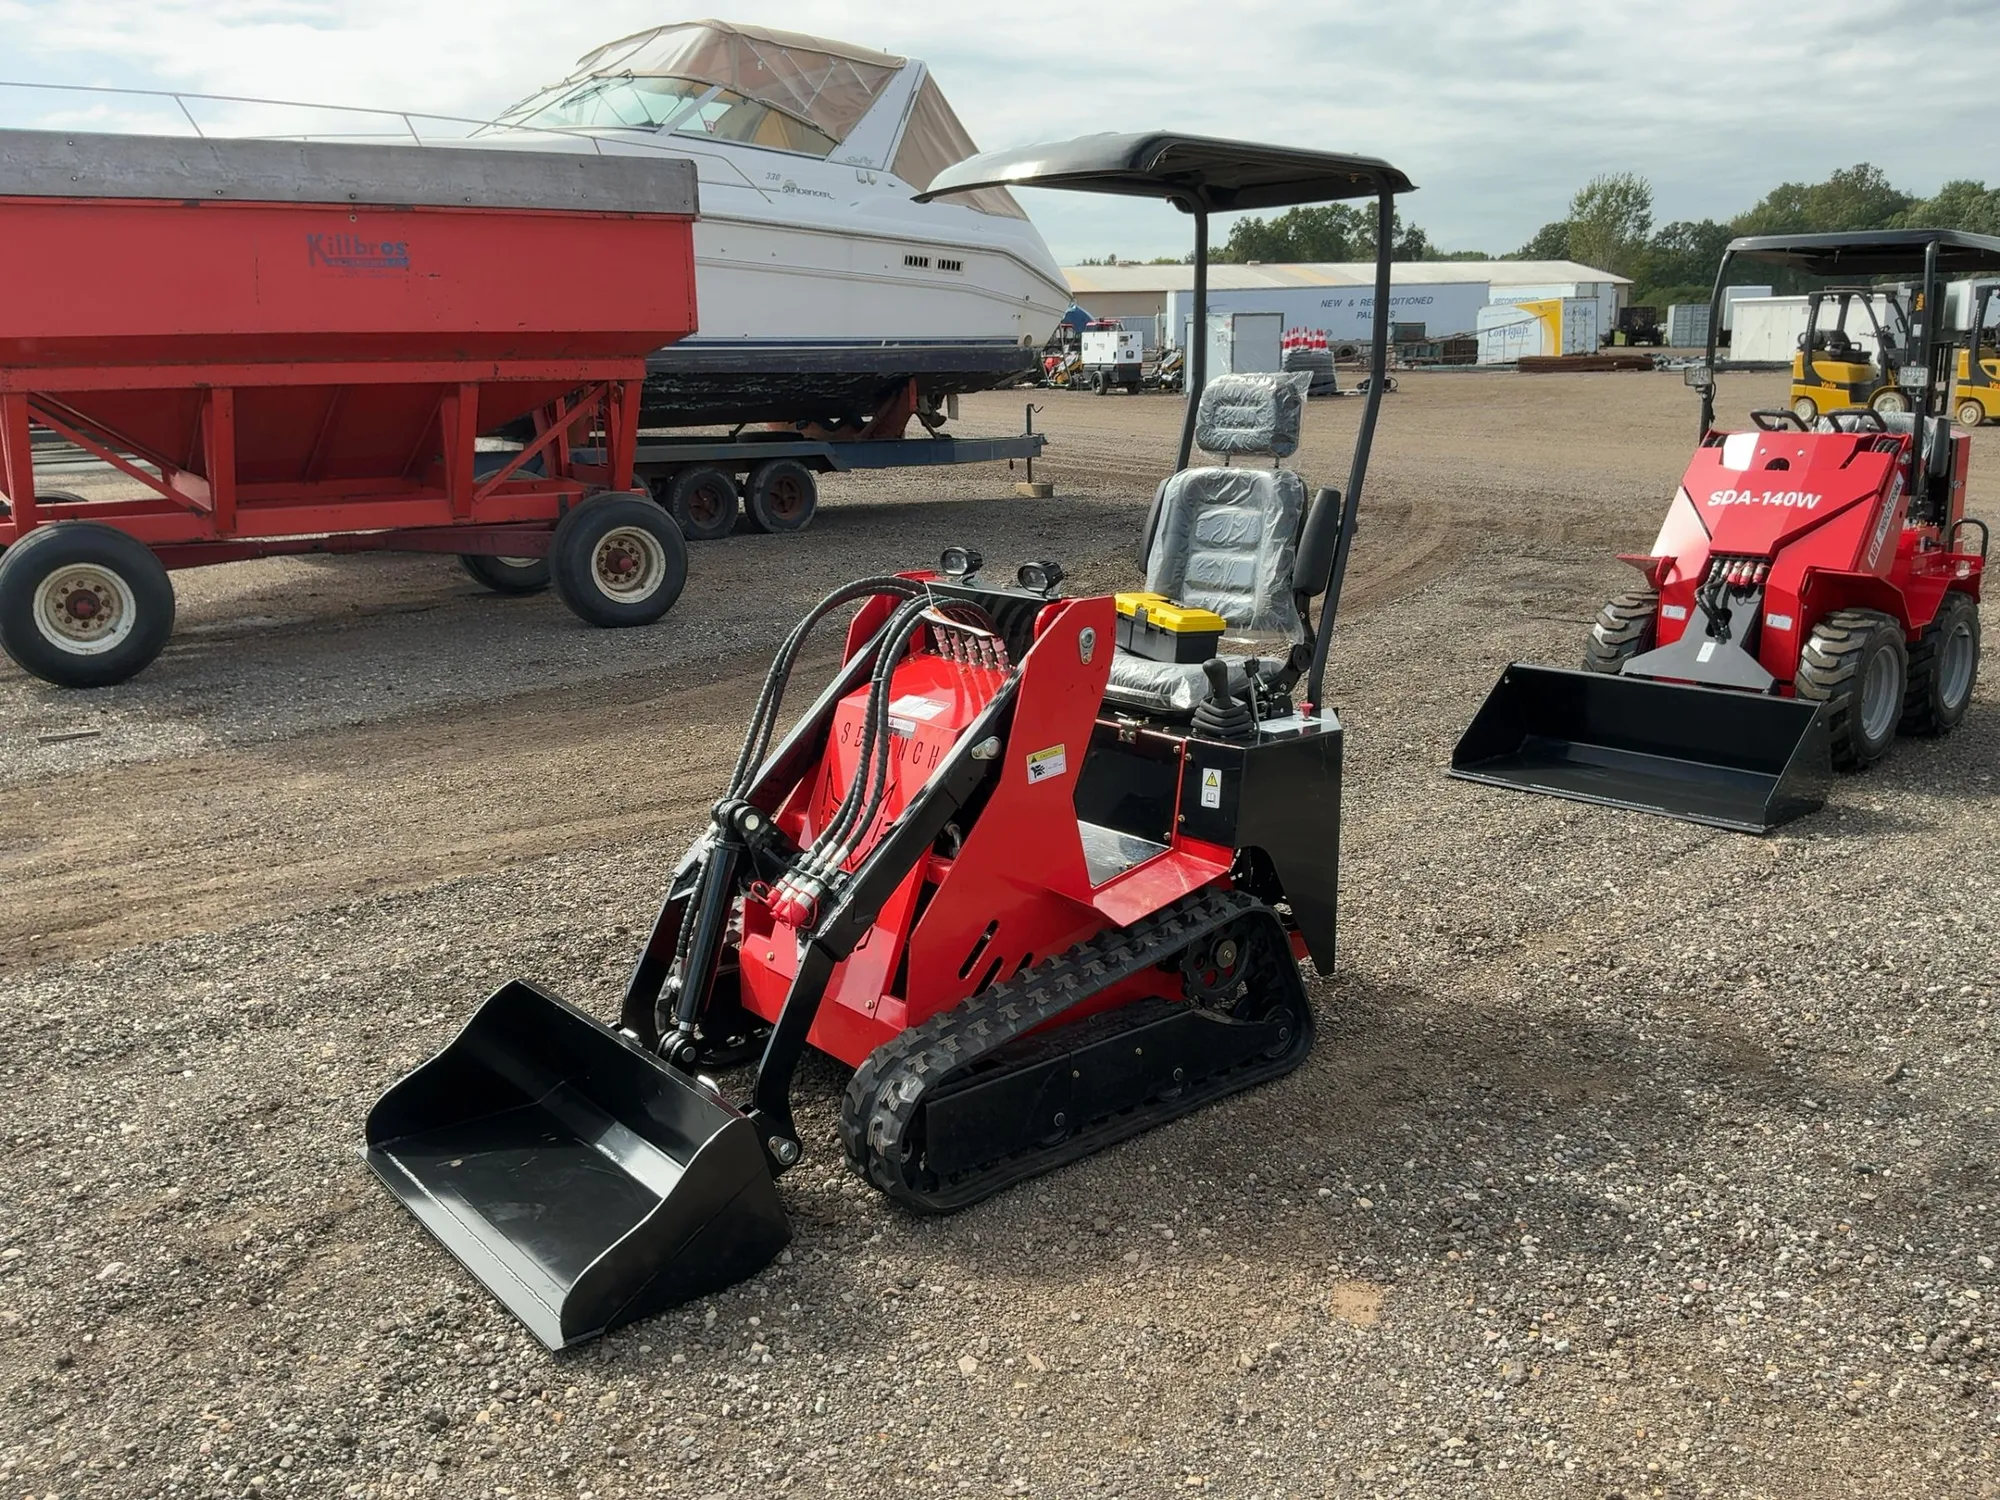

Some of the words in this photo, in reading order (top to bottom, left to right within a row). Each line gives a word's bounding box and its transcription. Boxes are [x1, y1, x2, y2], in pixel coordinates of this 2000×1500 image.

[1320, 299, 1342, 308] NEW
[1348, 299, 1355, 307] &
[1359, 296, 1434, 306] RECDITIONED
[1916, 293, 1924, 312] Yale
[1356, 310, 1396, 319] PALS
[1820, 381, 1837, 390] Yale
[1707, 490, 1822, 509] SDA-140W
